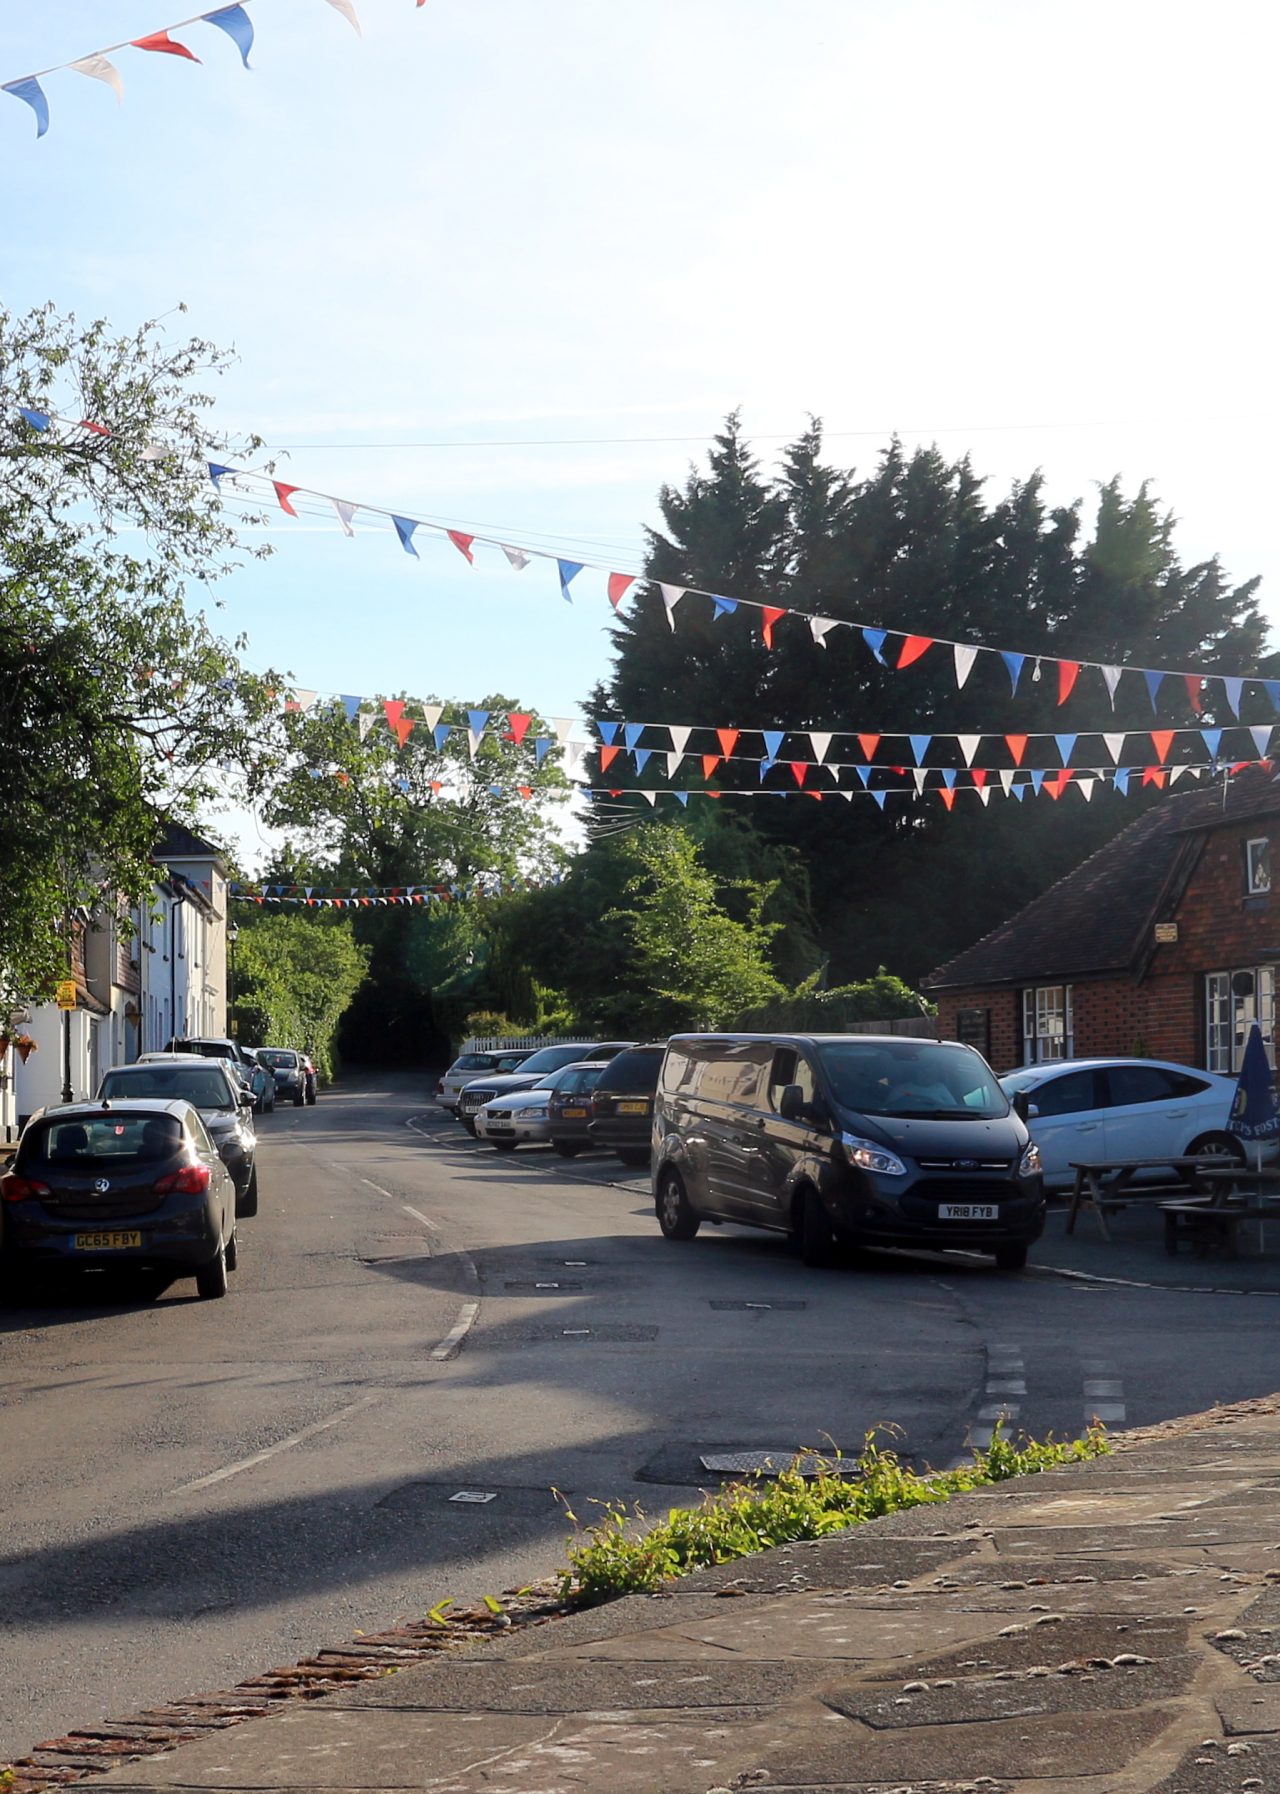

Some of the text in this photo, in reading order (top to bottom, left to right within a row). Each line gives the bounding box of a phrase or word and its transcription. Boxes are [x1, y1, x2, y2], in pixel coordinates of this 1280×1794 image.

[946, 1206, 993, 1218] YR18 FYB
[77, 1232, 138, 1246] GC65 FBY
